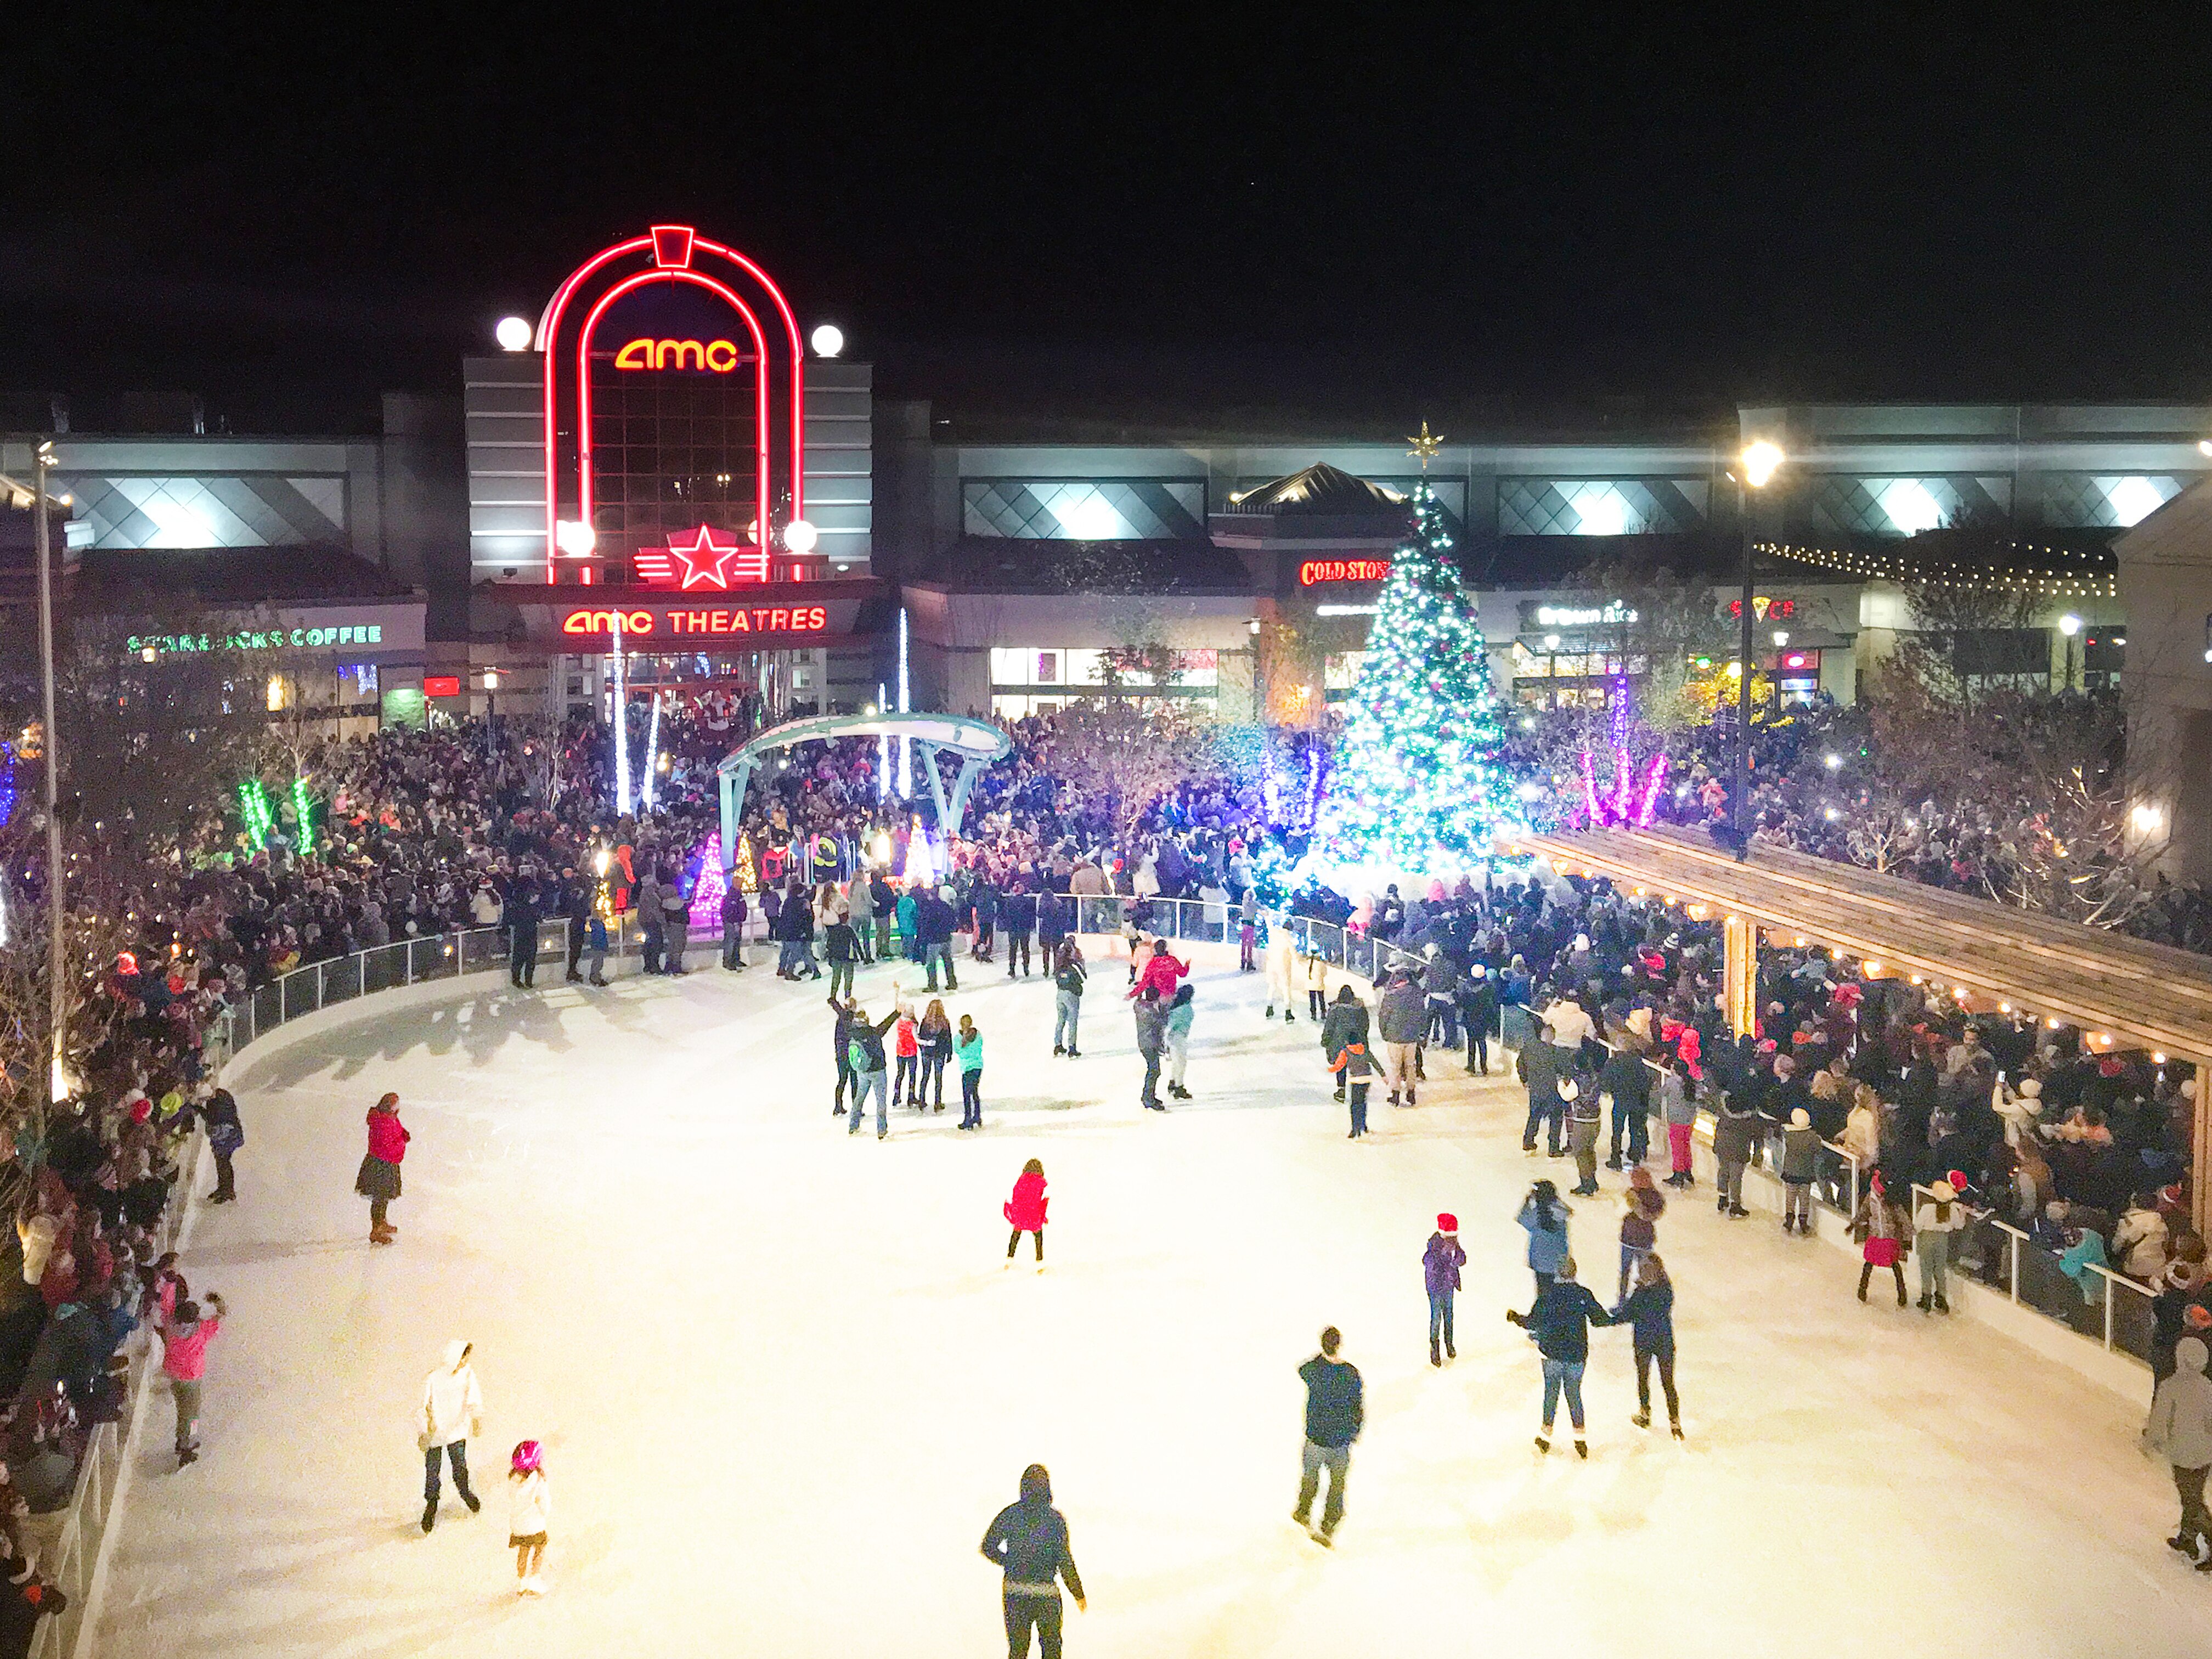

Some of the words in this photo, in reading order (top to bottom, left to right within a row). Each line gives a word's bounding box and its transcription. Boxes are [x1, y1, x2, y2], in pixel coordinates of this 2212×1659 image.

[1301, 561, 1345, 585] COLD
[1347, 561, 1391, 580] STON
[667, 607, 826, 634] THEATRES
[290, 625, 381, 647] COFFEE
